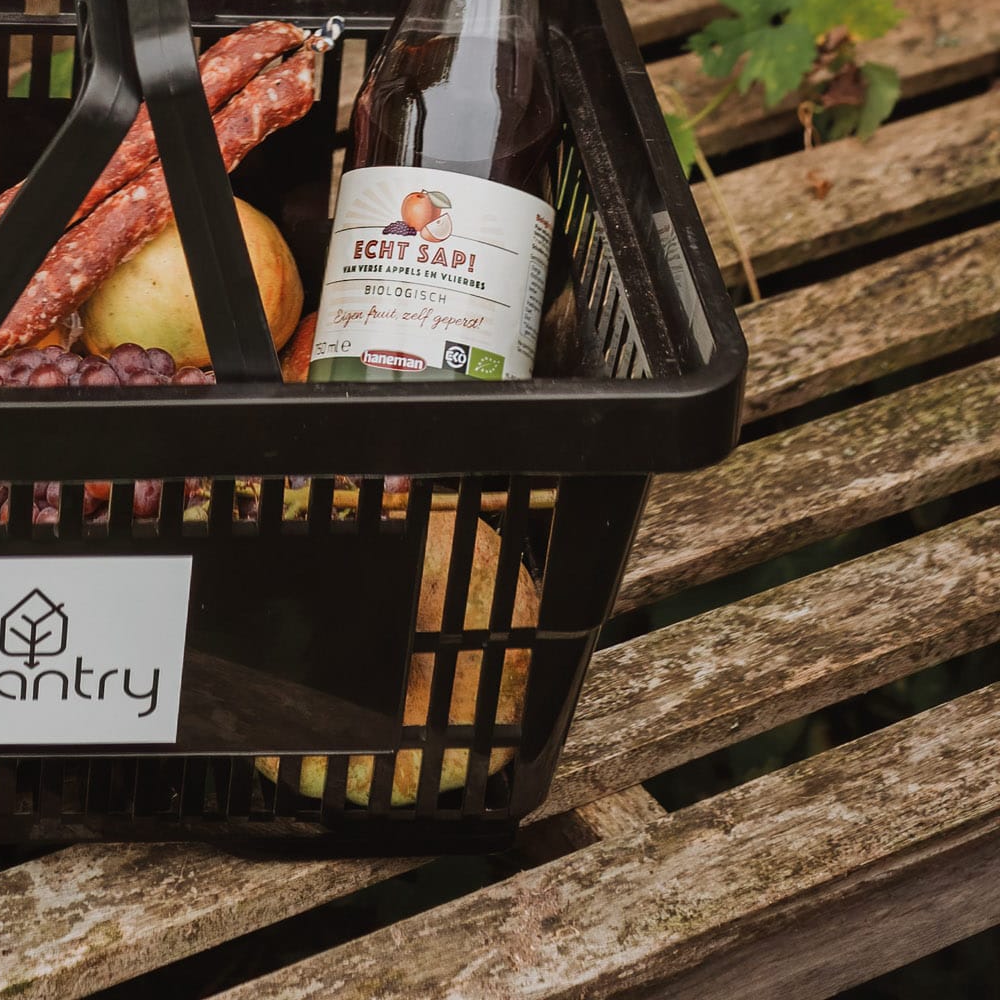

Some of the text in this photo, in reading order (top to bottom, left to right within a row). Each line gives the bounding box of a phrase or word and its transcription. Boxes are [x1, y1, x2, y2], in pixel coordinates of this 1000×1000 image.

[353, 240, 476, 273] ECHT SAP!
[342, 264, 486, 290] VAN VERSE APPELS EN VLIERBES
[364, 285, 447, 304] BIOLOGISCH
[333, 305, 486, 331] Eigen fruit, zelf geperst!
[364, 351, 424, 370] haneman
[445, 351, 467, 365] EKO
